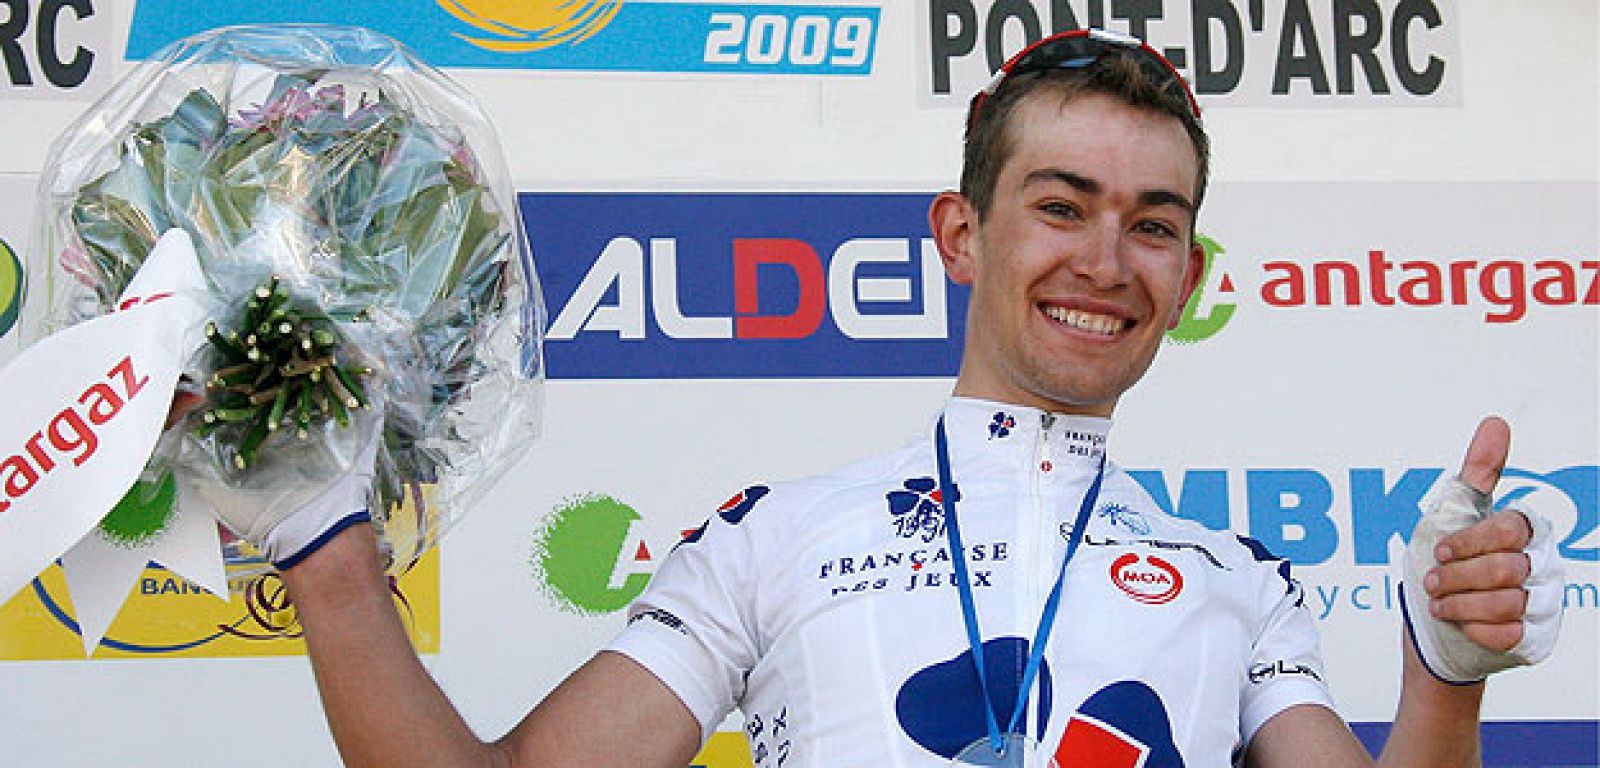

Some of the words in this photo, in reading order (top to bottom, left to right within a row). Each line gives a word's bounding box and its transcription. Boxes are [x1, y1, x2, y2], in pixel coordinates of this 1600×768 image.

[704, 14, 873, 65] 2009
[0, 356, 150, 512] argaz
[1124, 469, 1444, 566] MBK
[818, 542, 1008, 579] FRANÇASE
[1123, 570, 1171, 584] MOA
